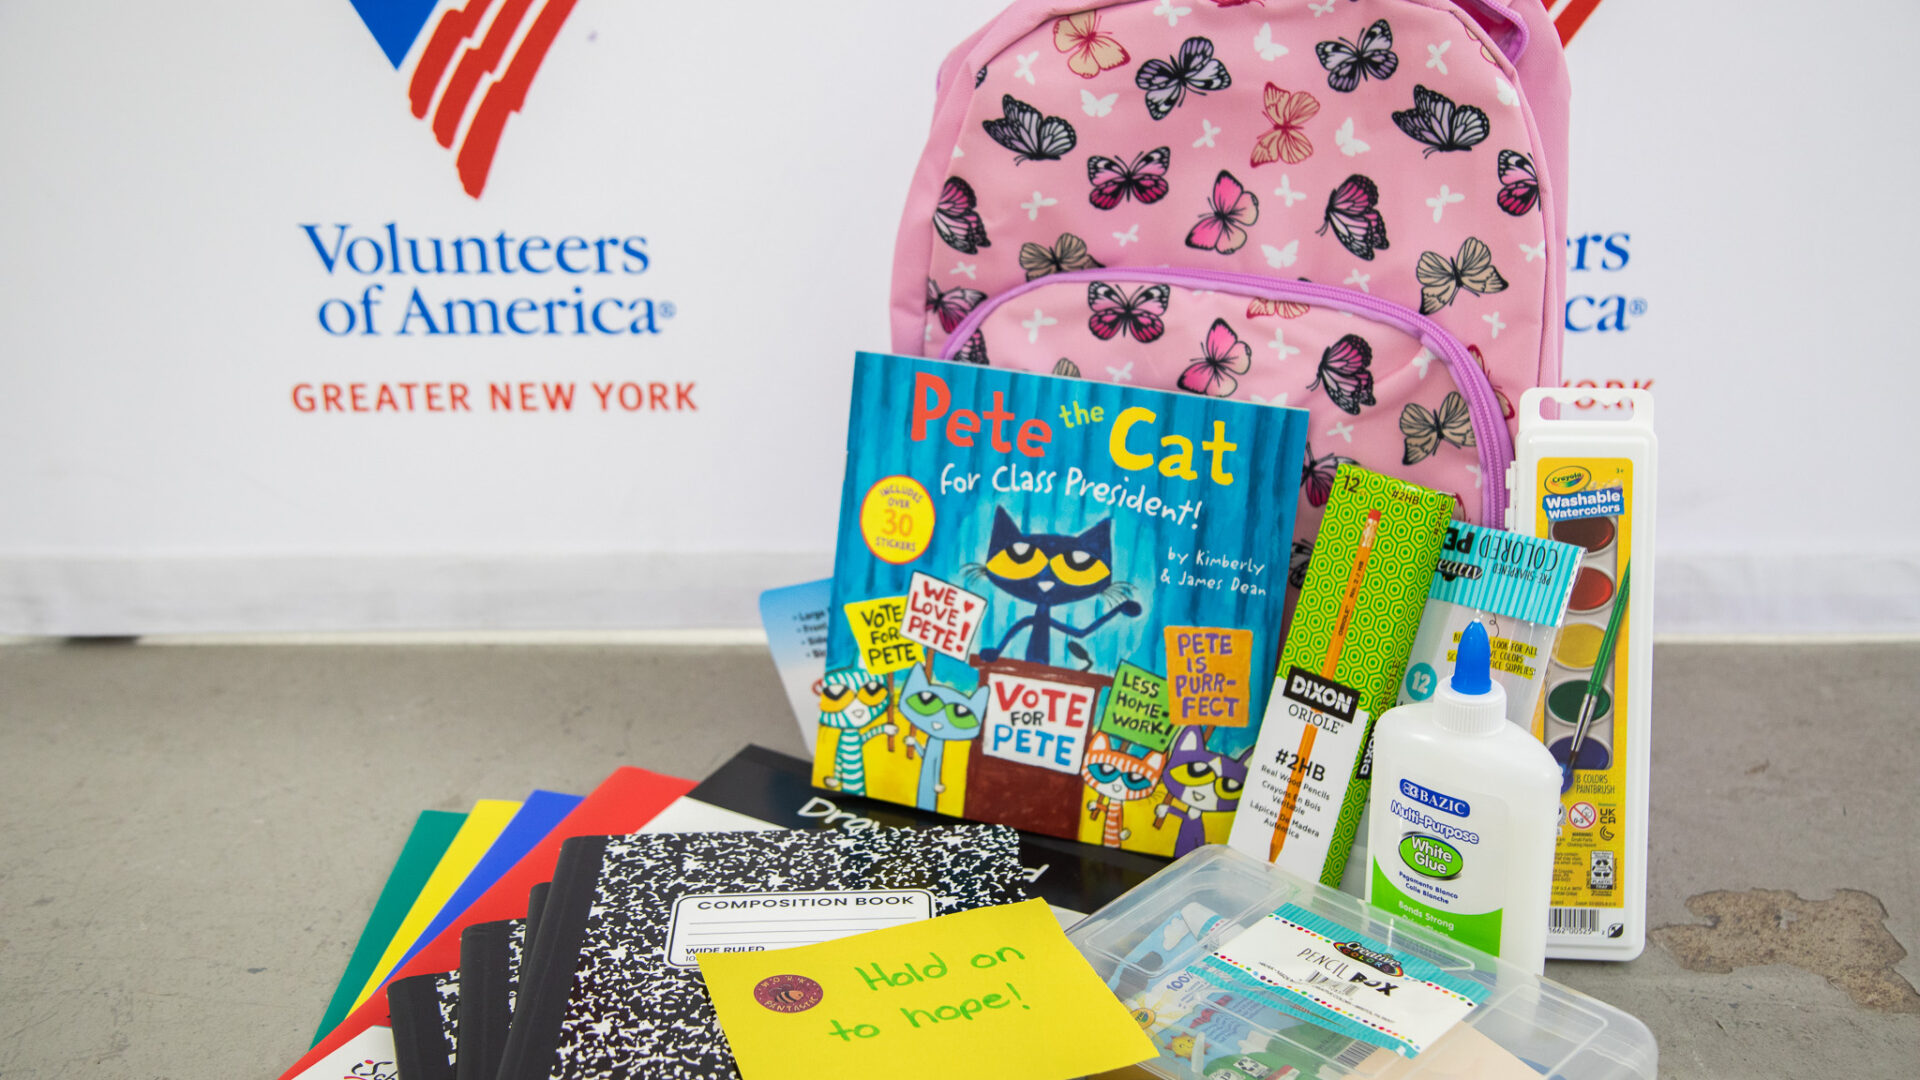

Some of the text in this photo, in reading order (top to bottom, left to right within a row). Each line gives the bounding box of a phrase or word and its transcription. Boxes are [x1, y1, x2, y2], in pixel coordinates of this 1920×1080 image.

[299, 222, 650, 275] Volunteers
[317, 284, 384, 336] of
[291, 382, 698, 413] GREATER NEW YORK
[911, 372, 1237, 486] Pete the Cat
[1552, 472, 1582, 484] Crayola
[888, 497, 910, 509] OVER
[941, 463, 1202, 530] for Class President!
[1391, 490, 1420, 506] #2HB
[1546, 490, 1620, 509] Washable
[882, 508, 913, 537] 30
[1548, 504, 1620, 519] Watercolors
[1168, 547, 1265, 575] by Kimberly
[1479, 534, 1558, 572] COLORED
[923, 580, 957, 607] WE
[1160, 568, 1266, 596] & James Dean
[861, 604, 902, 628] VOTE
[911, 591, 959, 627] LOVE
[870, 627, 899, 645] FOR
[908, 615, 970, 653] PETE!
[1176, 633, 1234, 657] PETE
[868, 643, 916, 667] PETE
[1187, 656, 1207, 674] IS
[1122, 671, 1160, 698] LESS
[1175, 672, 1237, 697] PURR-
[1290, 675, 1353, 714] DIXON
[1412, 671, 1431, 694] 12
[995, 682, 1088, 728] VOTE
[1010, 710, 1045, 726] FOR
[1182, 696, 1240, 720] FECT
[993, 724, 1076, 767] PETE
[1275, 748, 1326, 782] #2HB
[1261, 765, 1278, 777] Real
[1303, 783, 1330, 800] Pencils
[1576, 784, 1616, 794] PAINTBRUSH
[1583, 774, 1608, 784] COLORS
[1304, 799, 1321, 812] Bois
[1420, 790, 1467, 815] BAZIC
[1292, 820, 1320, 838] Madera
[1391, 800, 1479, 844] Multi-Purpose
[1411, 836, 1452, 863] White
[1415, 852, 1447, 874] Glue
[697, 895, 915, 911] COMPOSITION BOOK
[1435, 886, 1458, 899] Blanco
[1425, 912, 1454, 931] Strong
[854, 946, 1025, 991] Hold on
[1297, 947, 1349, 980] PENCIL
[828, 982, 1031, 1042] to hope!
